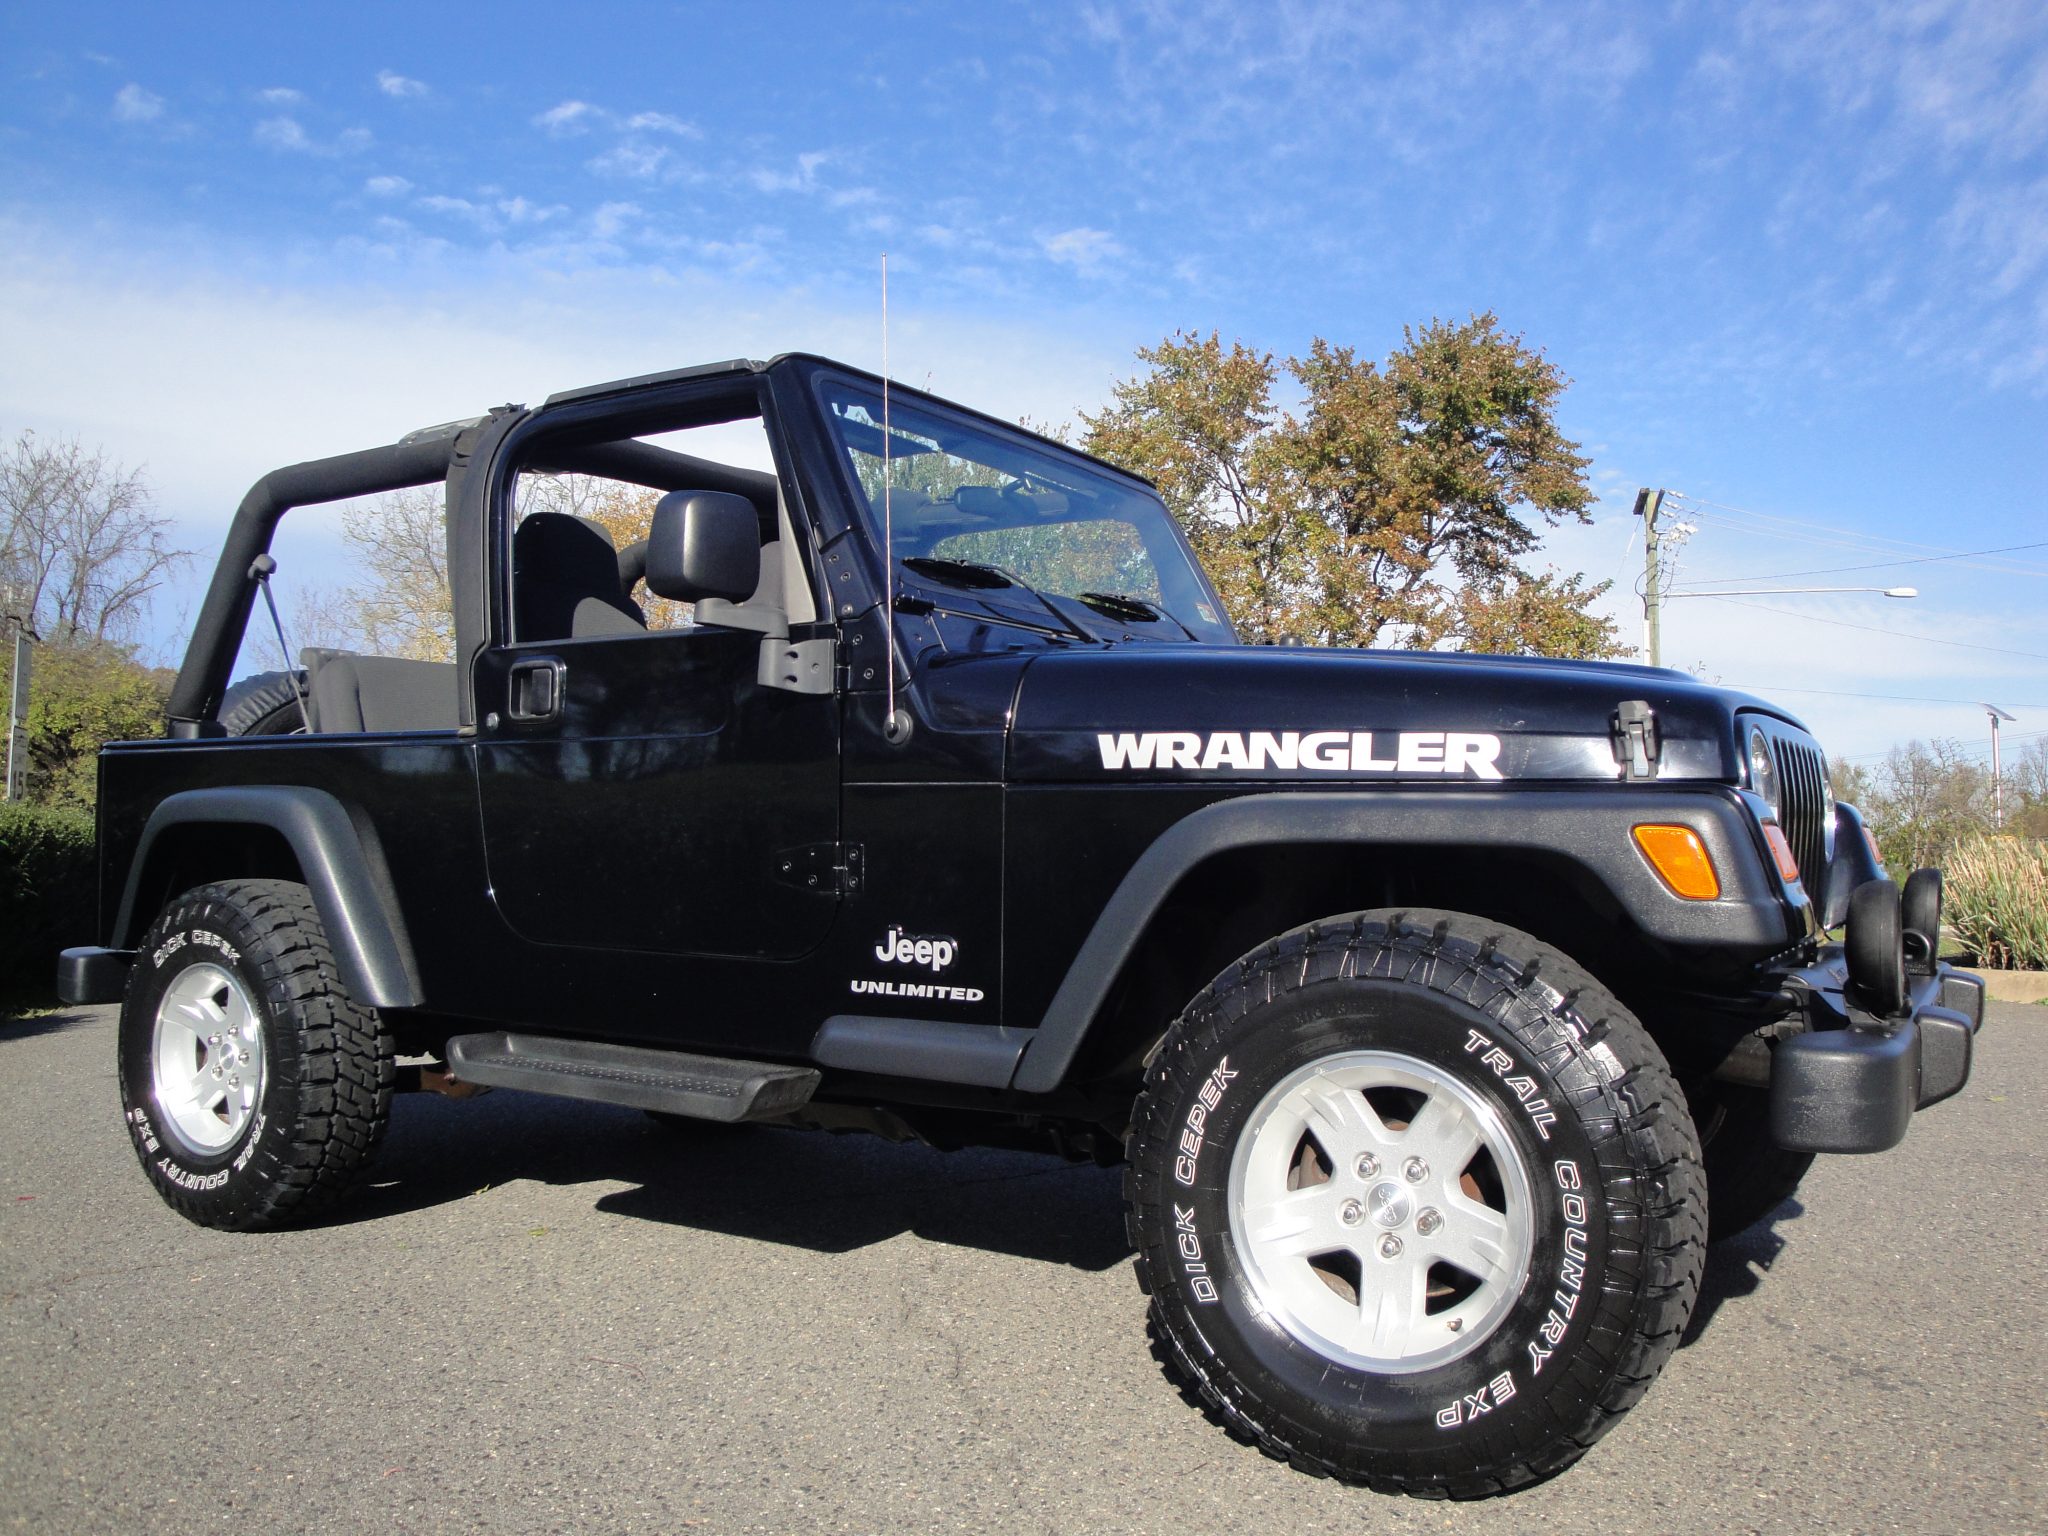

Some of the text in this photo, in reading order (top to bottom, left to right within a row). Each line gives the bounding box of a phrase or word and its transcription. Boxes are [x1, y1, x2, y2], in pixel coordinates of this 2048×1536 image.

[1096, 731, 1504, 779] WRANGLER
[153, 929, 241, 968] DICK CEPEK
[875, 930, 953, 972] Jeep
[850, 979, 984, 1002] UNLIMITED
[1175, 1055, 1239, 1185] CEPEK
[134, 1107, 266, 1190] TRAIL COUNTRY EXP
[1378, 1188, 1397, 1222] Jeep
[1436, 1028, 1587, 1428] TRAIL COUNTRY EXP
[1175, 1203, 1219, 1301] DICK
